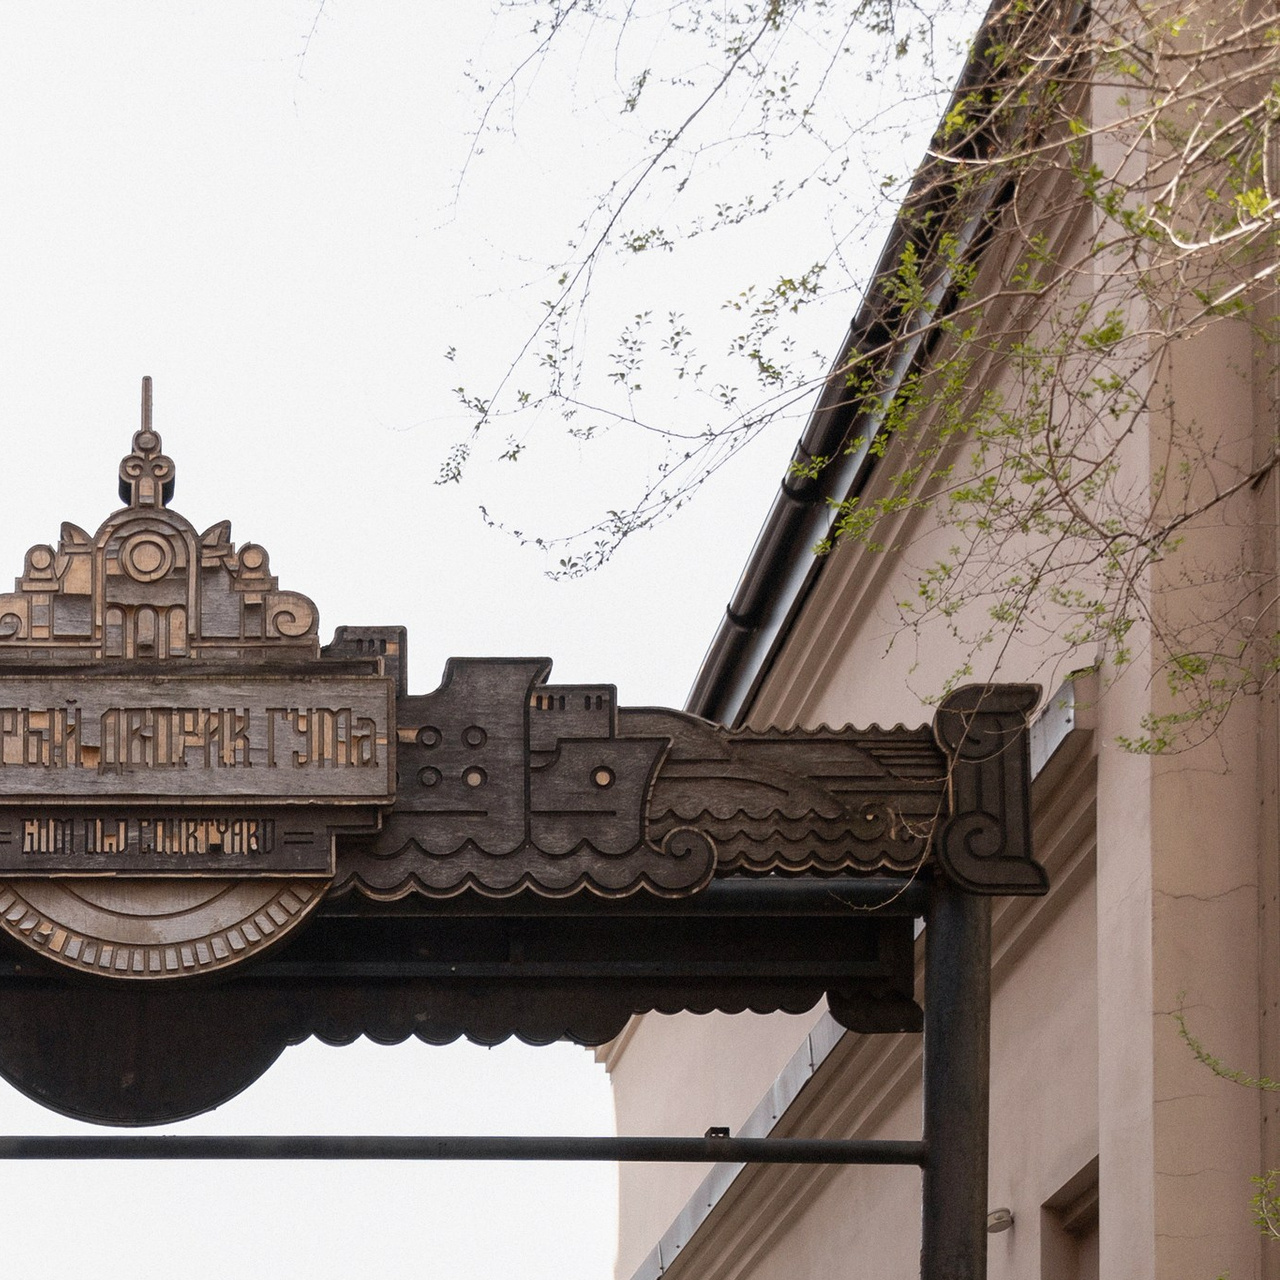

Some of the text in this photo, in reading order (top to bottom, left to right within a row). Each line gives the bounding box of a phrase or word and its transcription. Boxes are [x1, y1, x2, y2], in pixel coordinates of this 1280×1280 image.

[97, 706, 253, 776] ДВОРИК
[21, 818, 275, 855] GUM OLD COURTYARD
